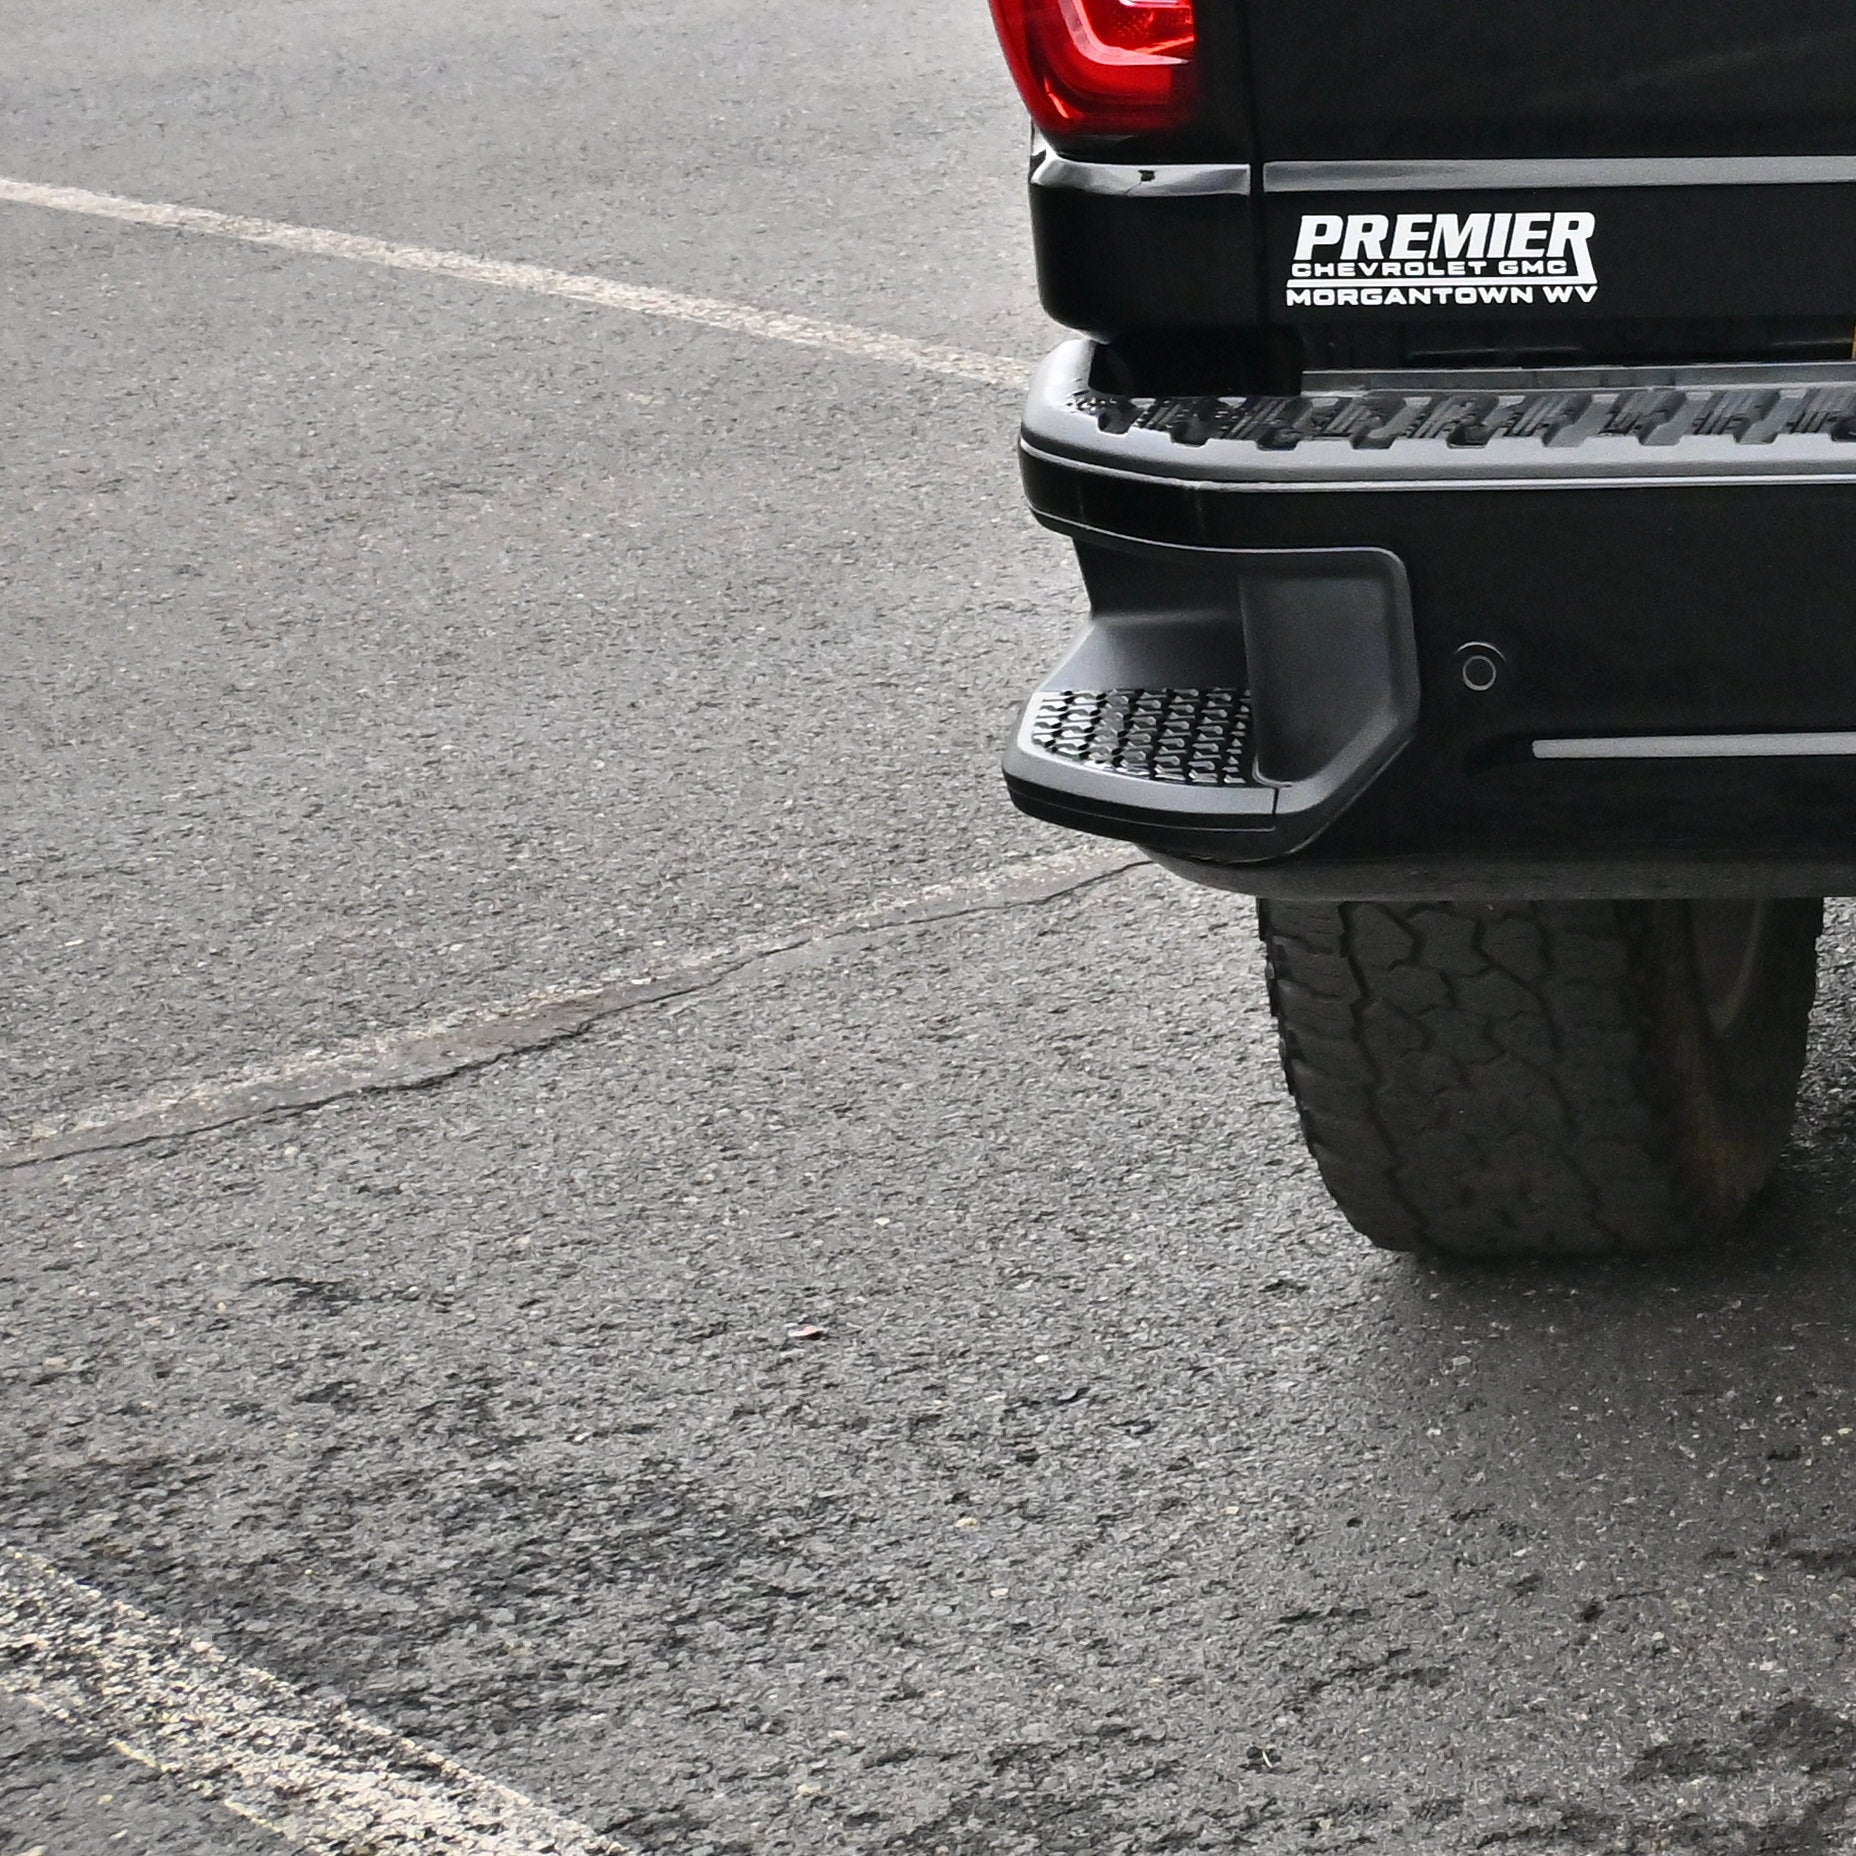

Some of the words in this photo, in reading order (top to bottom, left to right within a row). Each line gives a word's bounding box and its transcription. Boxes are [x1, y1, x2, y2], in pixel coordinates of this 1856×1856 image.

[1293, 212, 1598, 283] PREMIER
[1291, 260, 1488, 277] CHEVROLET
[1498, 259, 1567, 275] GMC
[1286, 287, 1534, 306] MORGANTOWN
[1543, 286, 1598, 304] WV
